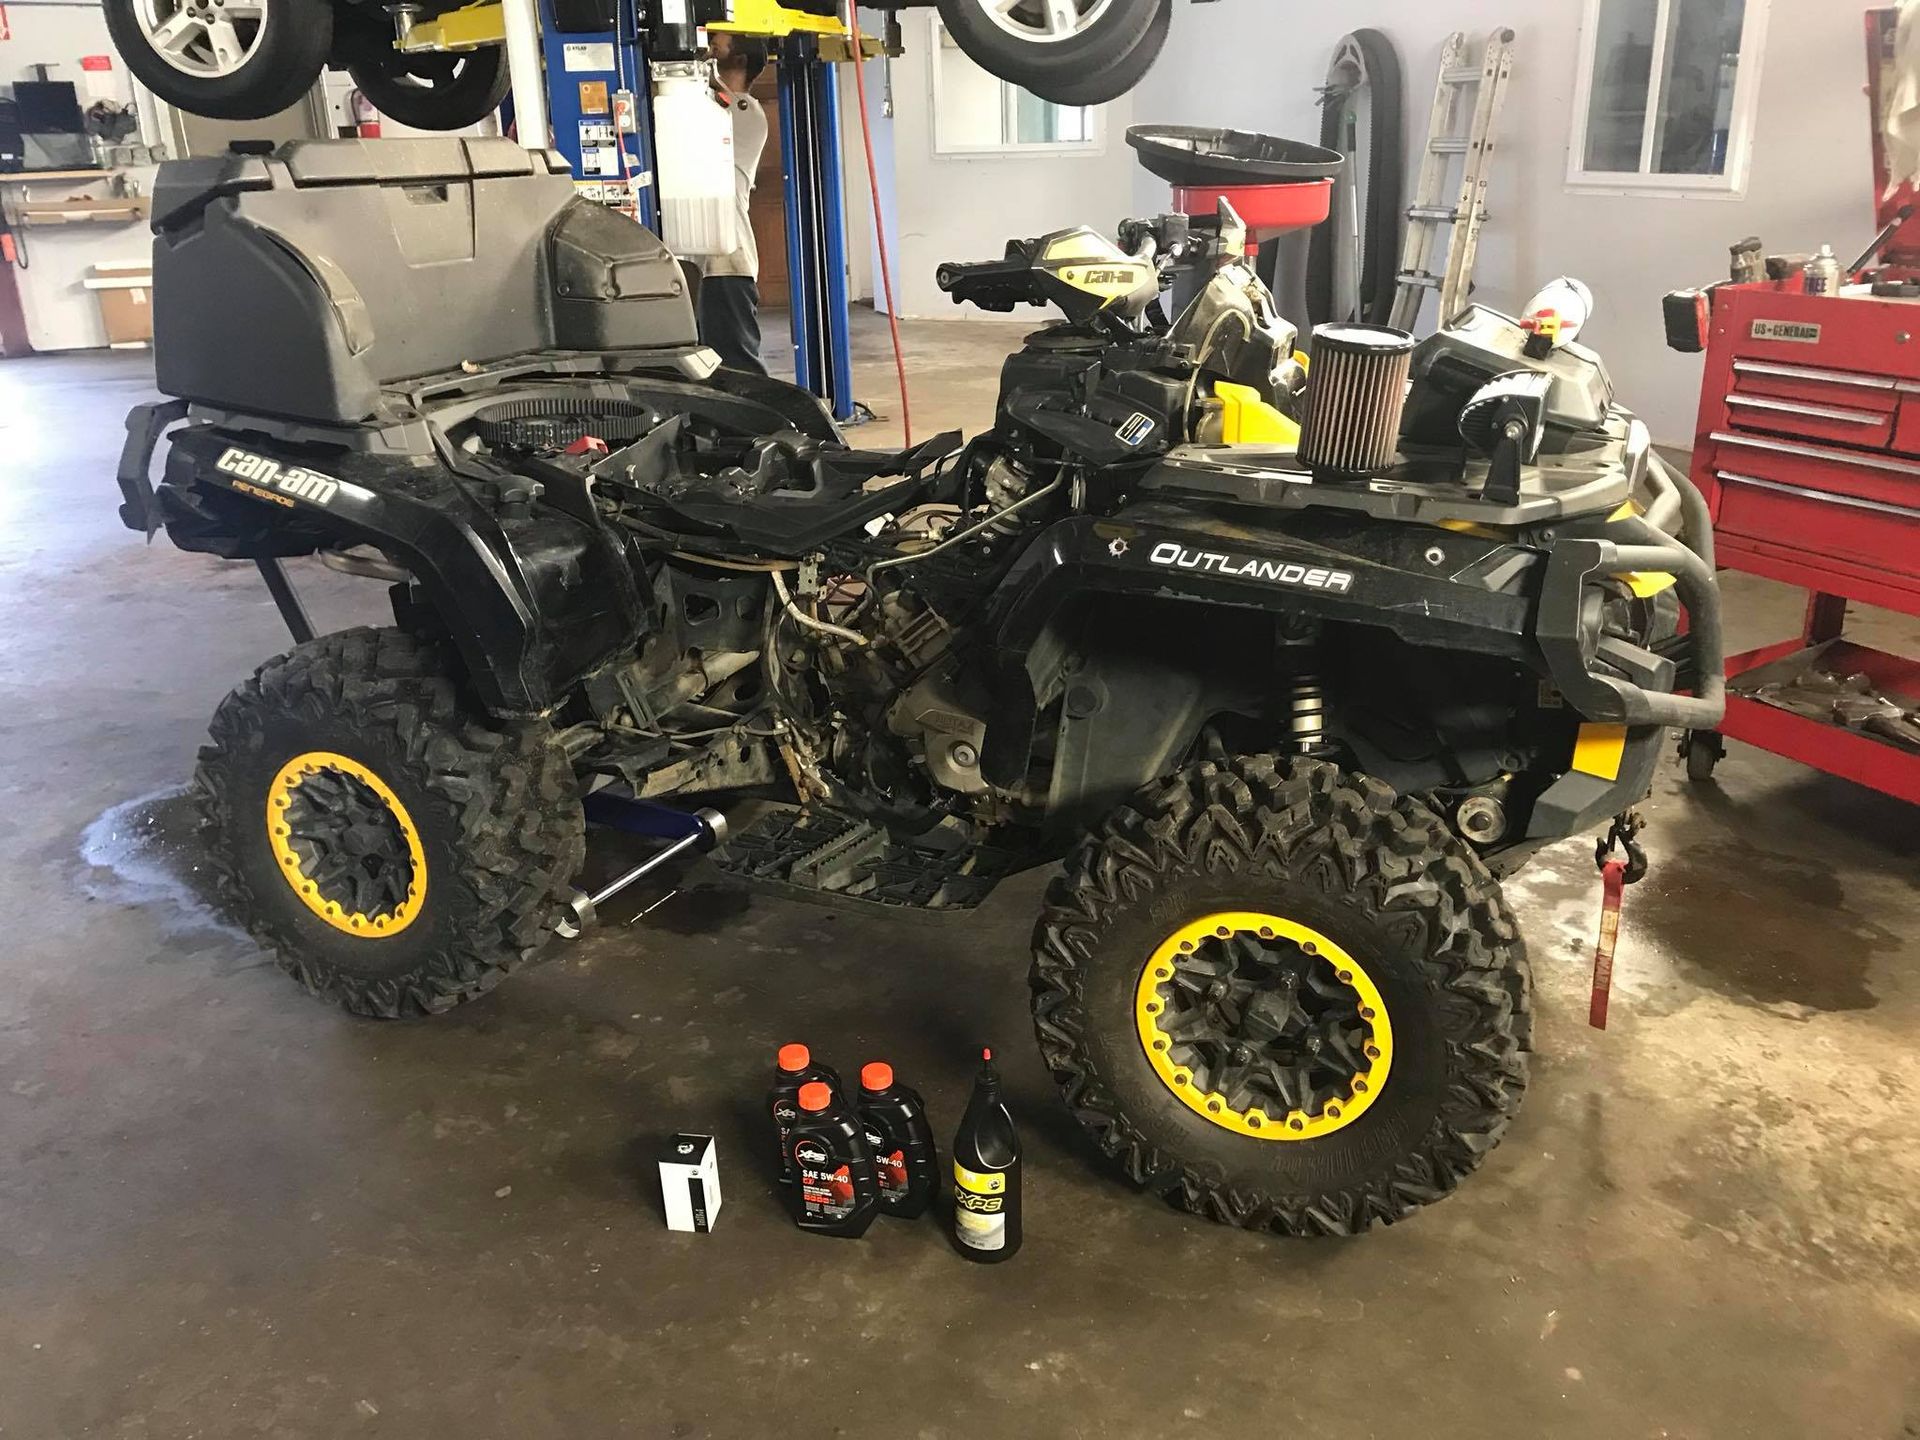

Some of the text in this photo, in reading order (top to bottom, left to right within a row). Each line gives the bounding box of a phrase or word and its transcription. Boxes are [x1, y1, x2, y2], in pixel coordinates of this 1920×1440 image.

[217, 448, 339, 504] can-am
[1150, 543, 1352, 591] OUTLANDER
[876, 1155, 903, 1168] 5W-40
[803, 1170, 818, 1179] SAE
[820, 1172, 848, 1184] 5W-40
[958, 1190, 1003, 1212] XPS
